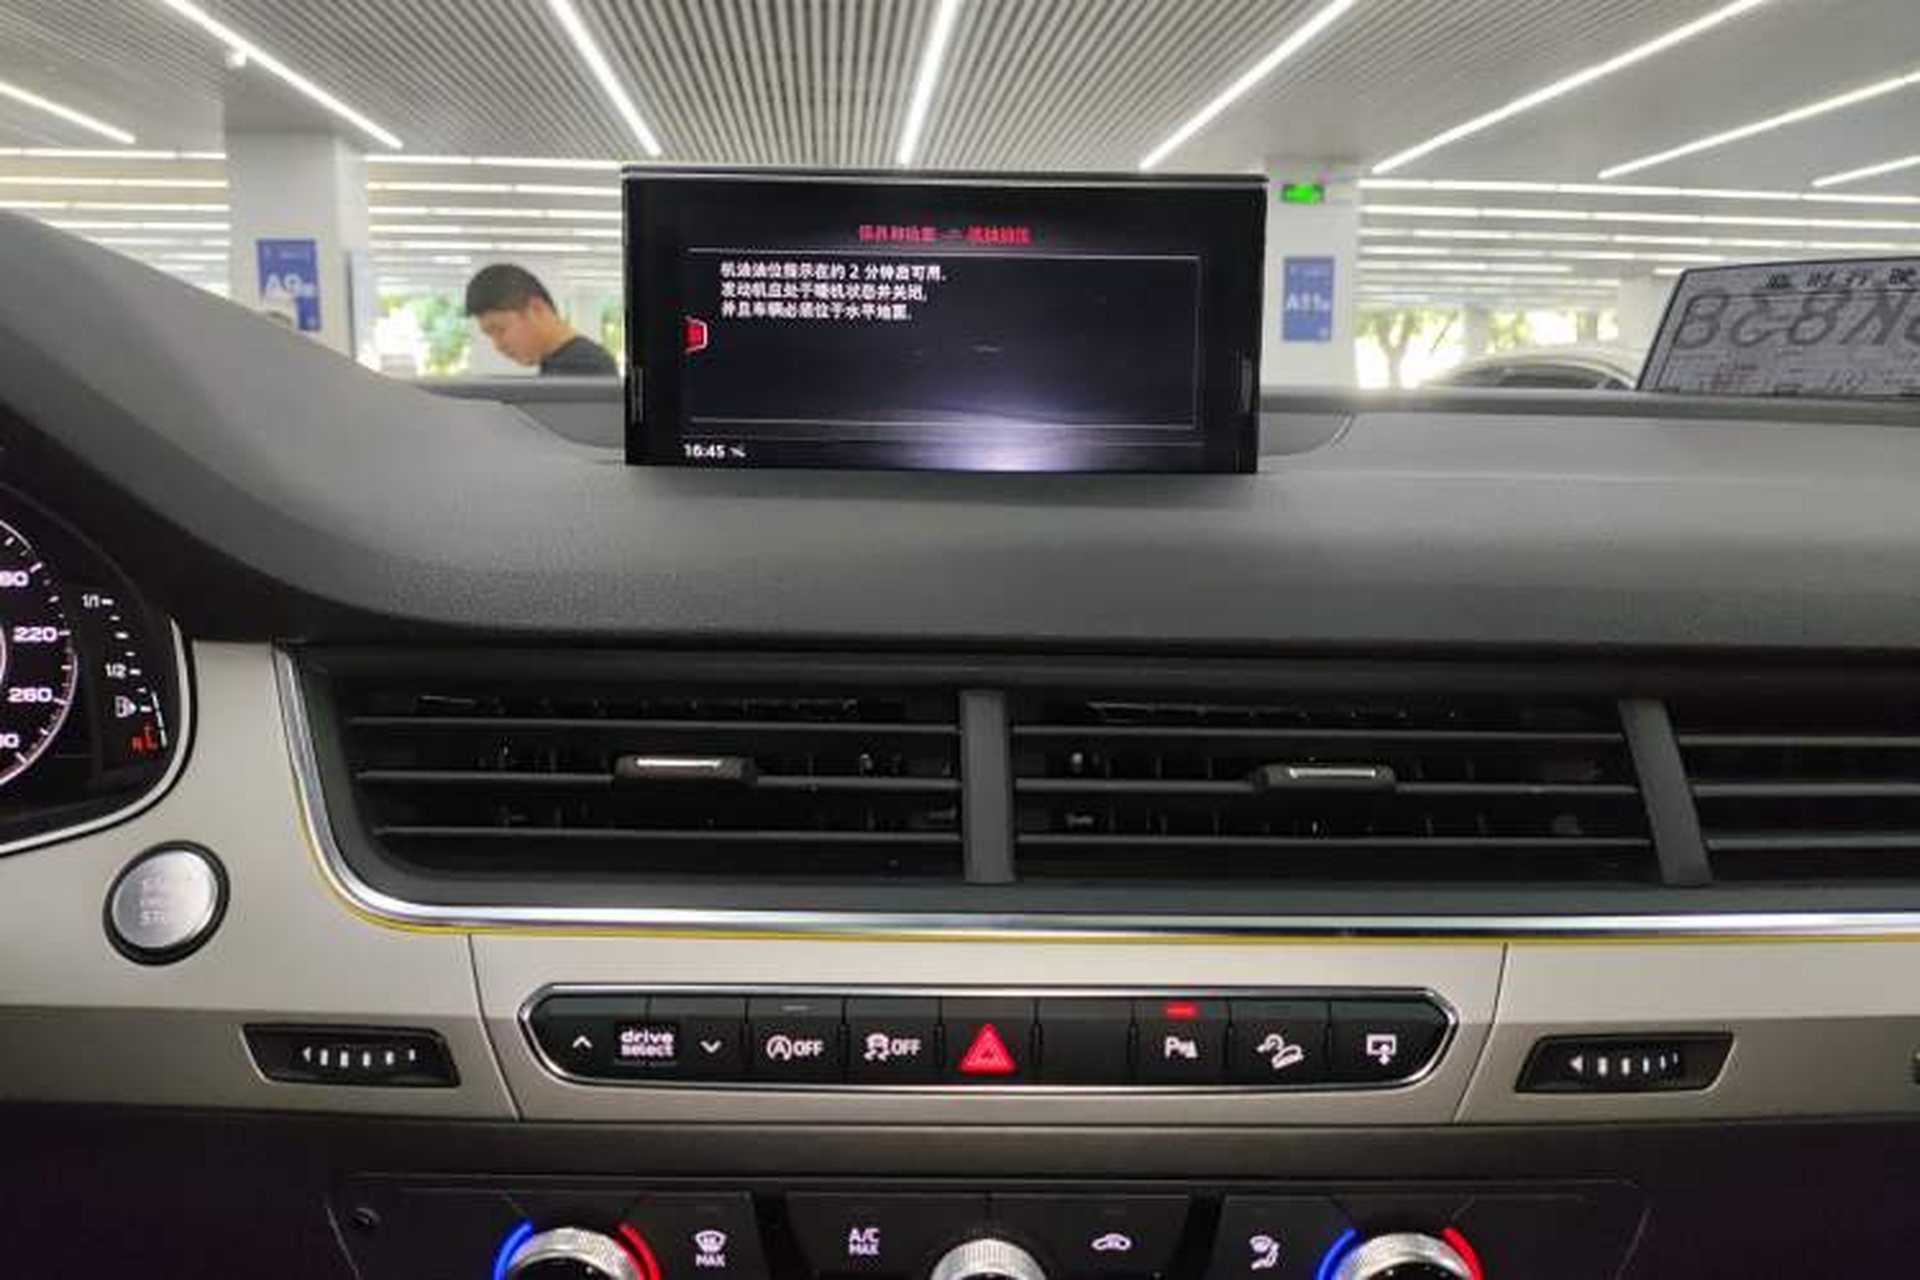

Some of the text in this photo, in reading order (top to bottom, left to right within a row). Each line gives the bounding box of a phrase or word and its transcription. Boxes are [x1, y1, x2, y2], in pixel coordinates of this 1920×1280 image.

[850, 265, 860, 280] 2
[13, 626, 57, 642] 220
[8, 687, 52, 702] 260
[621, 1029, 673, 1043] drive
[621, 1043, 673, 1057] select
[793, 1040, 824, 1057] OFF
[891, 1039, 922, 1056] OFF
[849, 1228, 880, 1242] A/C
[849, 1242, 880, 1255] MAX
[695, 1254, 725, 1267] MAX
